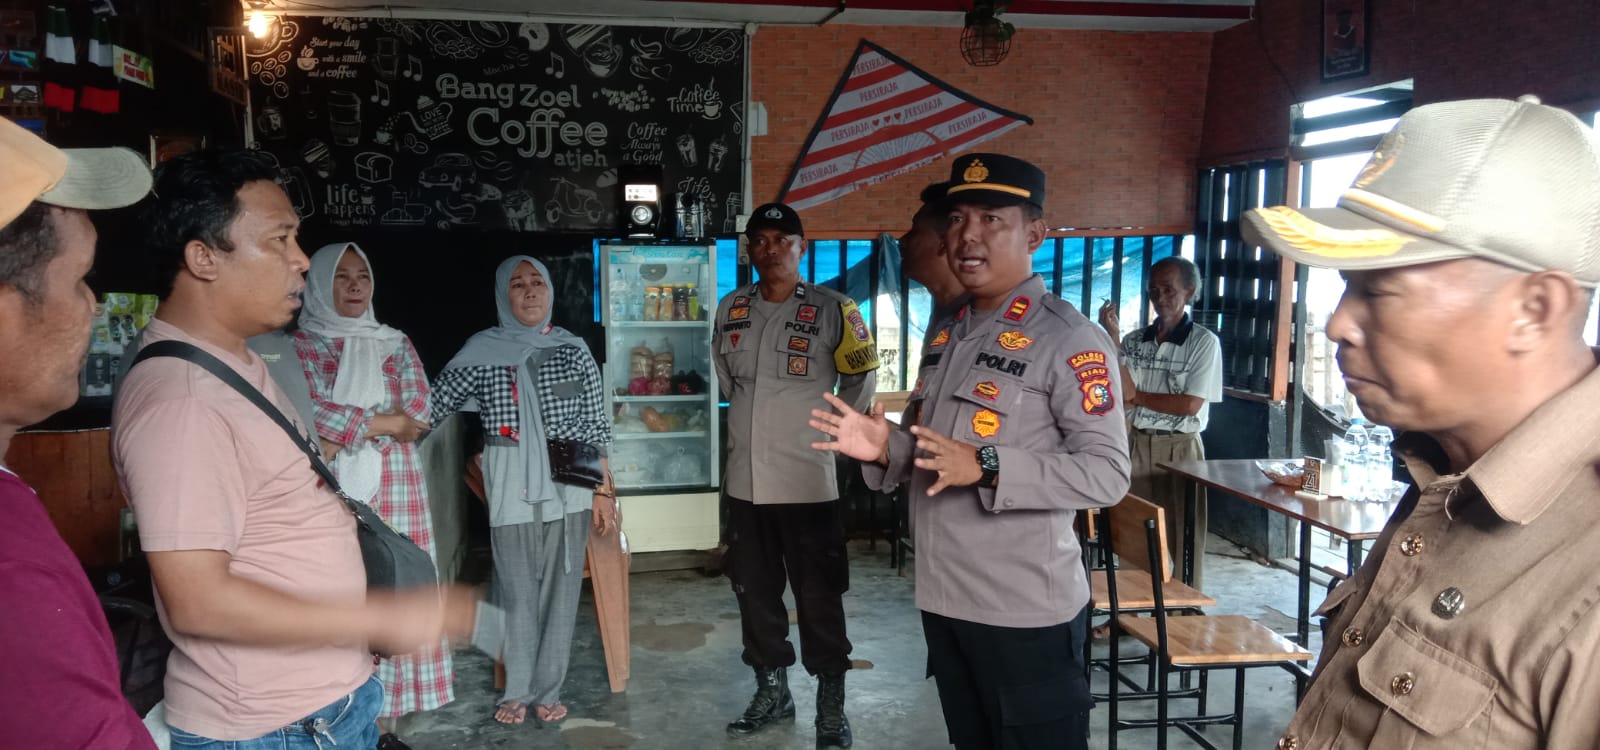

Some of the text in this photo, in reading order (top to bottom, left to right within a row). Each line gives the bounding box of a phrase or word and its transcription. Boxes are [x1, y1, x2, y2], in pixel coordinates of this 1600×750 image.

[309, 36, 328, 48] Start
[343, 35, 360, 50] day
[341, 50, 367, 63] smile
[852, 56, 891, 75] PERSIRAJA
[325, 65, 357, 79] coffee
[435, 73, 582, 108] Bang Zoel
[679, 83, 720, 102] Coffee
[859, 81, 899, 102] PERSIRAJA
[666, 96, 705, 112] Time
[419, 106, 443, 122] LOVE
[830, 98, 943, 142] PERSIRAJA PERSIRAJA
[947, 111, 987, 133] PERSIRAJA
[467, 107, 608, 158] Coffee
[627, 121, 668, 140] Coffee
[553, 149, 608, 172] atjeh
[632, 149, 664, 165] Good
[800, 163, 839, 184] PERSIRAJA
[784, 321, 820, 337] POLRI
[975, 352, 1027, 378] POLRI
[1071, 352, 1104, 364] POLRES
[1080, 368, 1106, 378] RIAU
[1304, 471, 1317, 489] 21
